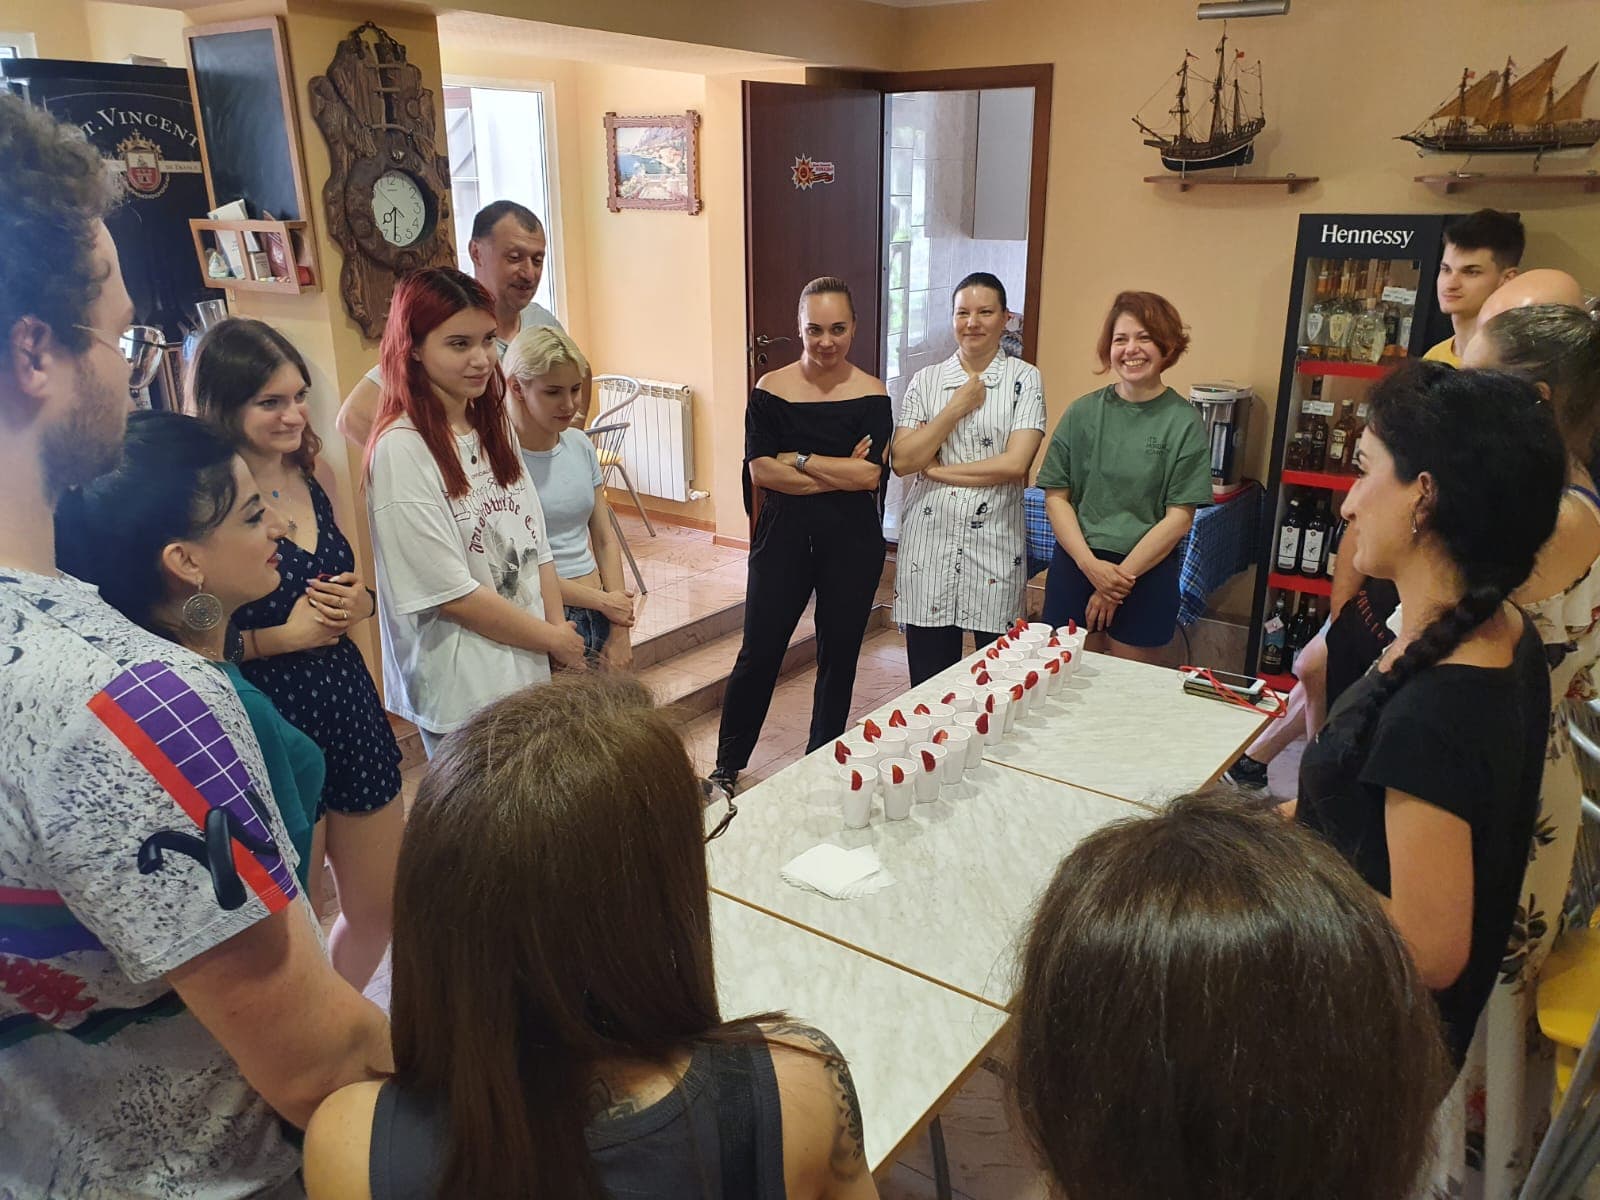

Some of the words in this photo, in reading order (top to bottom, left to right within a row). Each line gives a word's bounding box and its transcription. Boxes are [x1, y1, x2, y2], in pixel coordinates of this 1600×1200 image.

[81, 121, 103, 137] T.
[409, 187, 417, 199] 2
[413, 202, 421, 214] 3
[412, 217, 419, 228] 4
[405, 228, 413, 240] 5
[1321, 224, 1415, 248] Hennessy
